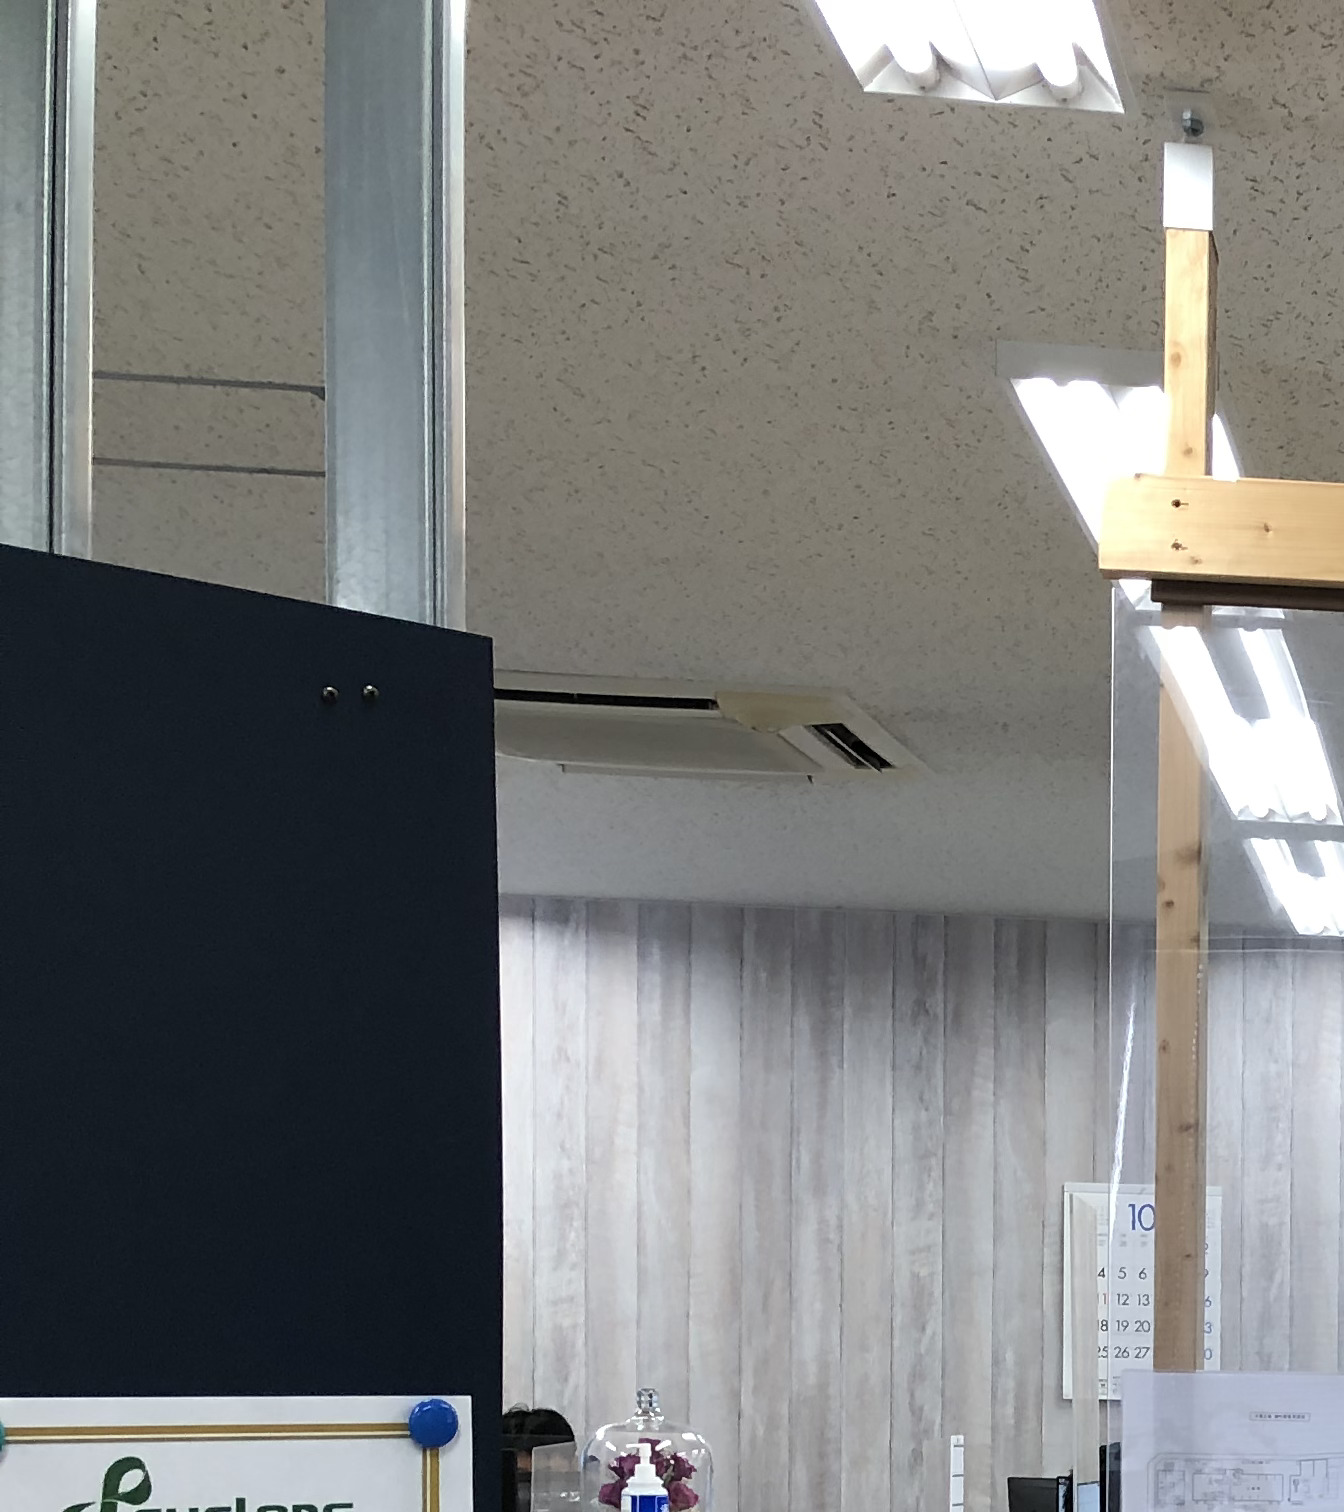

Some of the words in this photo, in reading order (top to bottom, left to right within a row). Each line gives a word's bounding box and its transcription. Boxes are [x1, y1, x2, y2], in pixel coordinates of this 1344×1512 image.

[1127, 1203, 1155, 1231] 10
[1117, 1267, 1127, 1280] 5
[1138, 1267, 1148, 1280] 6
[1116, 1293, 1129, 1306] 12
[1137, 1293, 1150, 1307] 13
[1115, 1320, 1129, 1332] 19
[1134, 1320, 1150, 1332] 20
[1114, 1347, 1129, 1359] 26
[1134, 1347, 1150, 1359] 27
